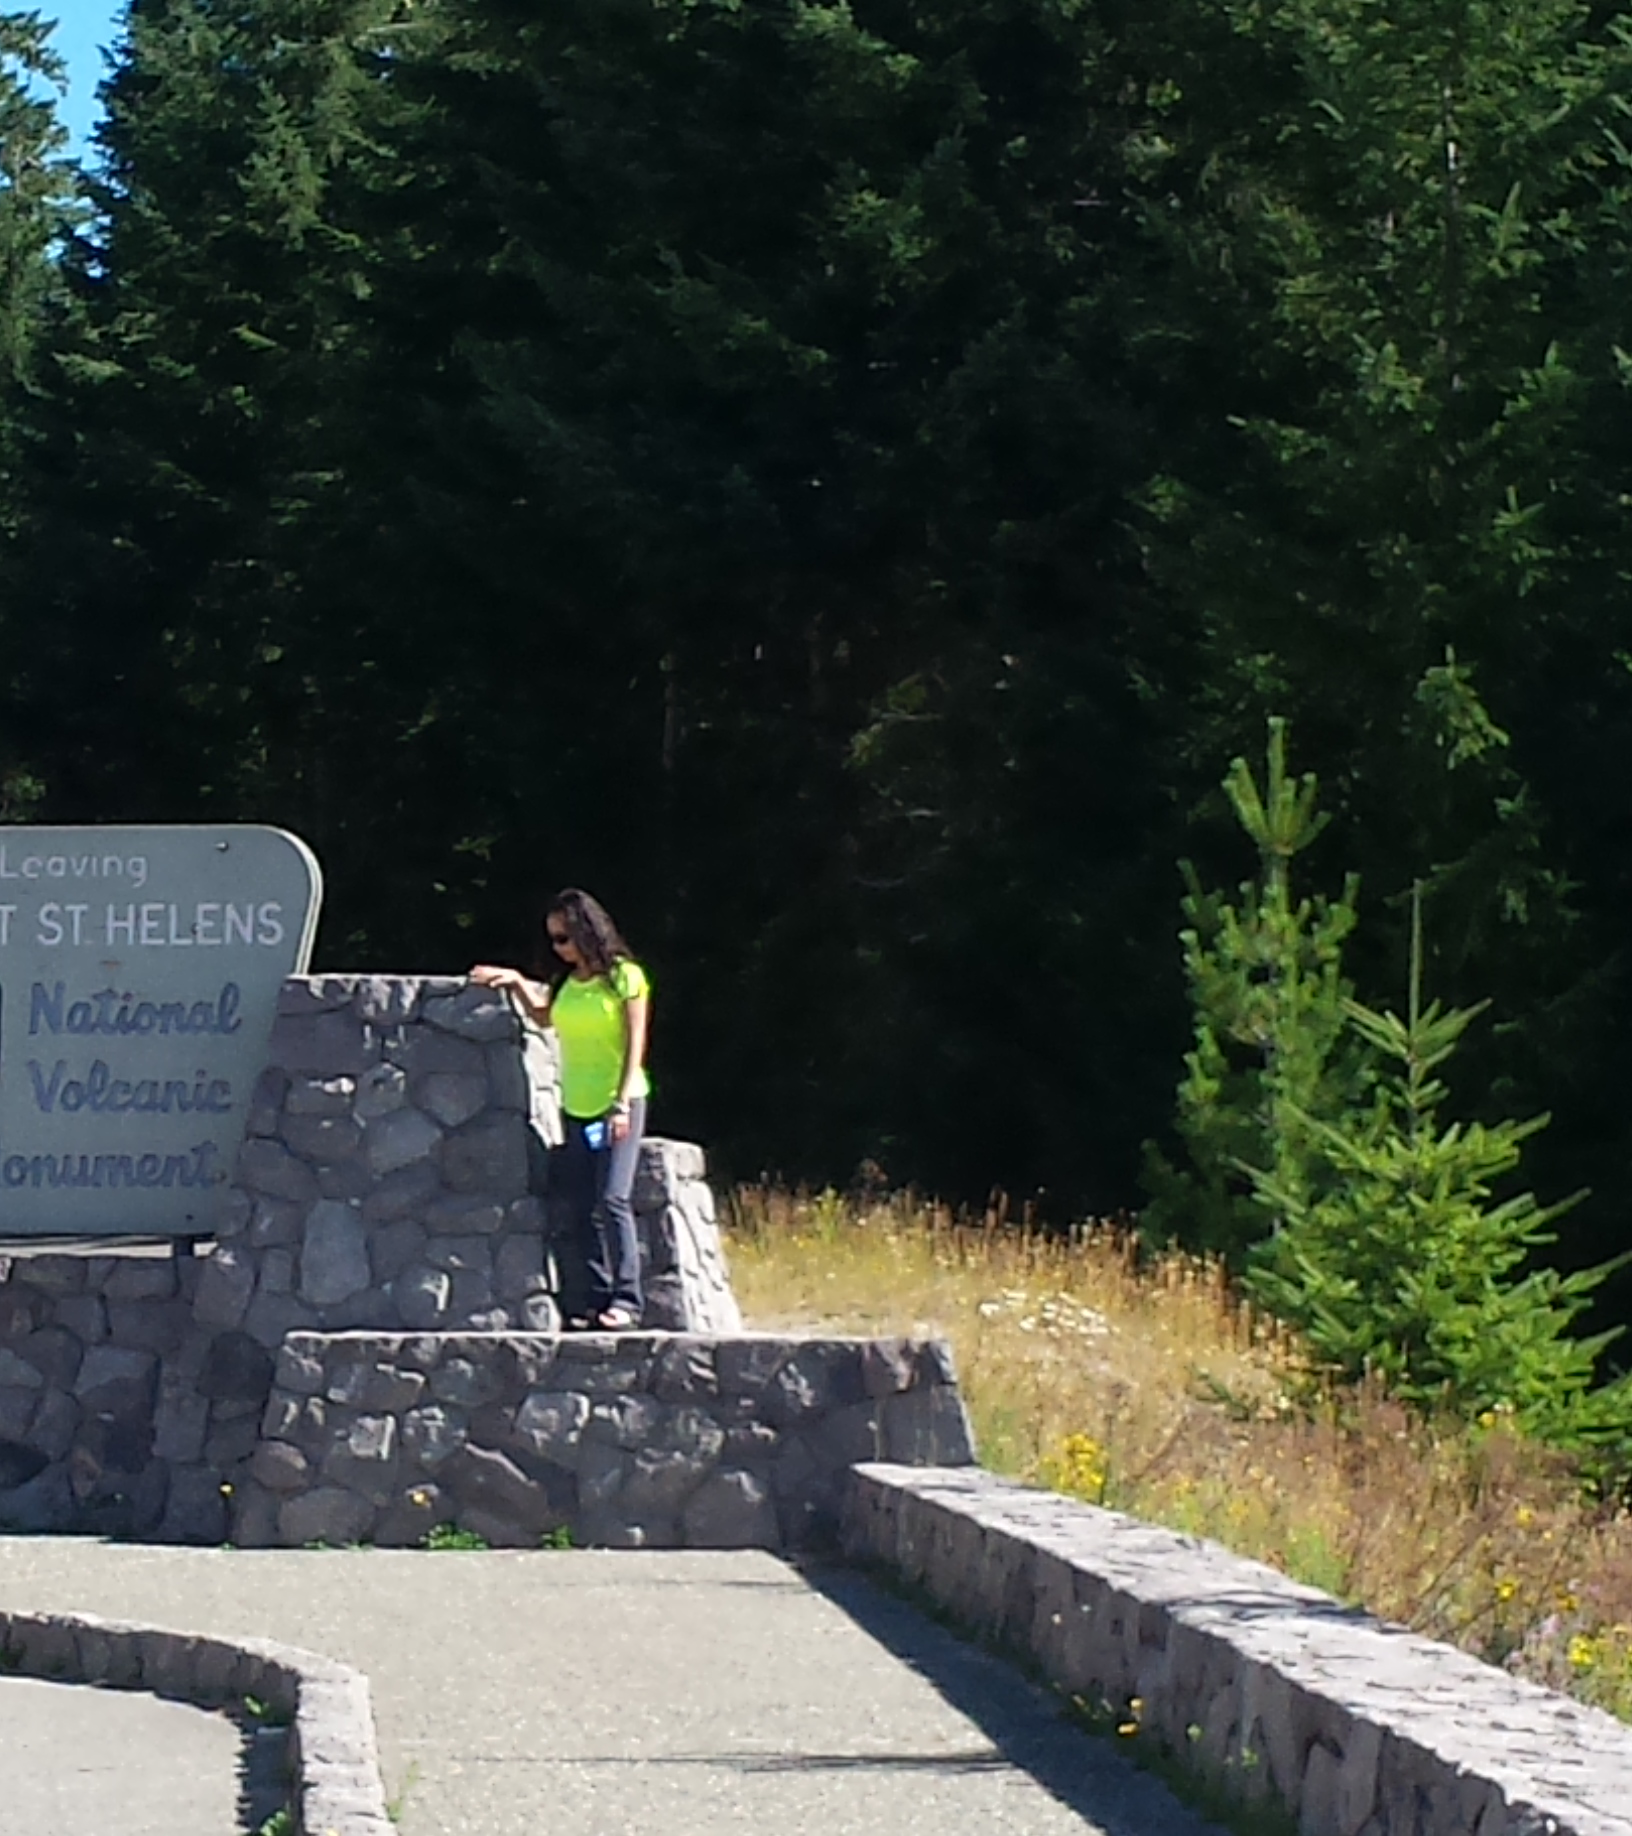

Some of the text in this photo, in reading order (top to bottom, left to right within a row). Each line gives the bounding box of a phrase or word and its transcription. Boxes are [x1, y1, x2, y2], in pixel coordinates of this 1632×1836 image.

[0, 844, 148, 888] Leaving
[106, 901, 285, 947] HELENS
[28, 981, 242, 1036] National
[28, 1059, 232, 1113] Volcanic
